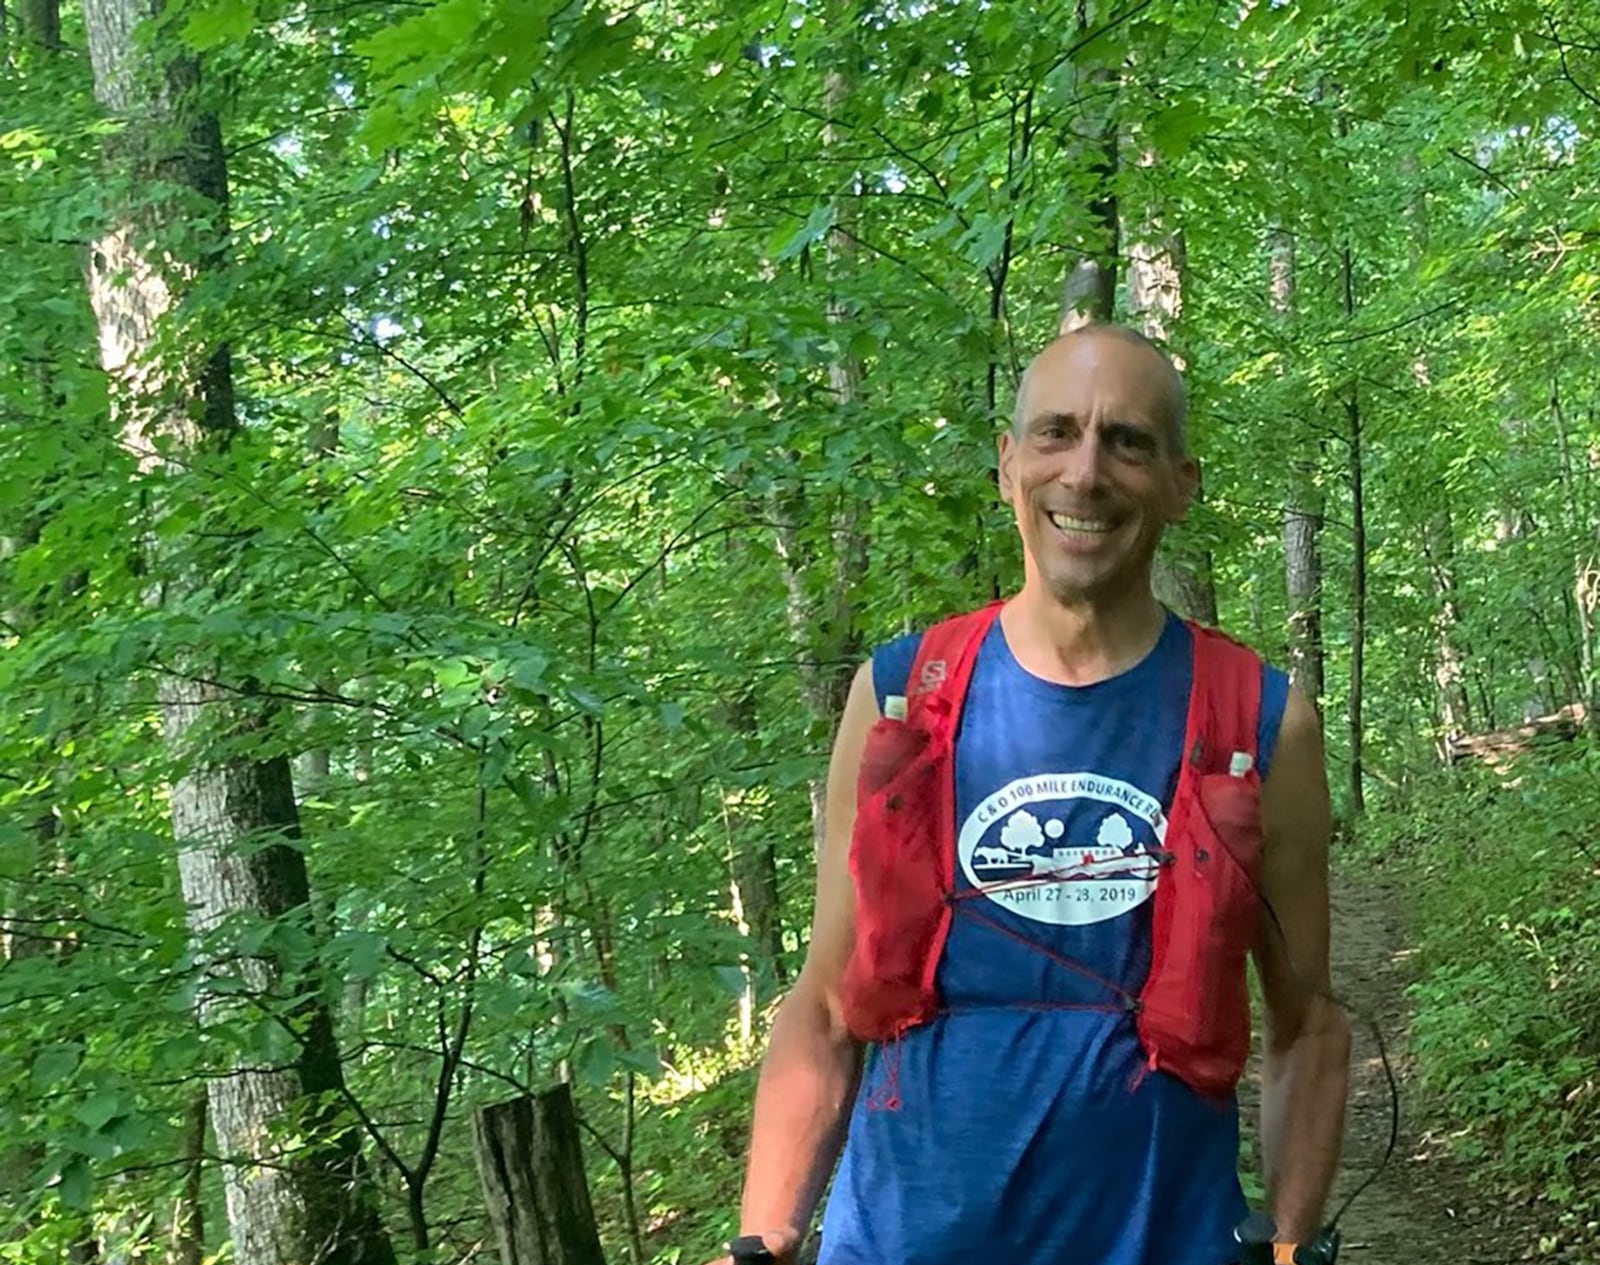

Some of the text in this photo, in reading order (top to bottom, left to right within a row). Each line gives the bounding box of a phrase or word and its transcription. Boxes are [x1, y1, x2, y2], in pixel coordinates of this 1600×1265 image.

[977, 811, 989, 823] C
[986, 803, 998, 816] &
[1009, 784, 1034, 801] 100
[1036, 780, 1067, 794] MILE
[1070, 780, 1145, 810] ENDURANCE
[1003, 888, 1041, 904] April
[1045, 888, 1062, 902] 27
[1099, 887, 1136, 901] 2019
